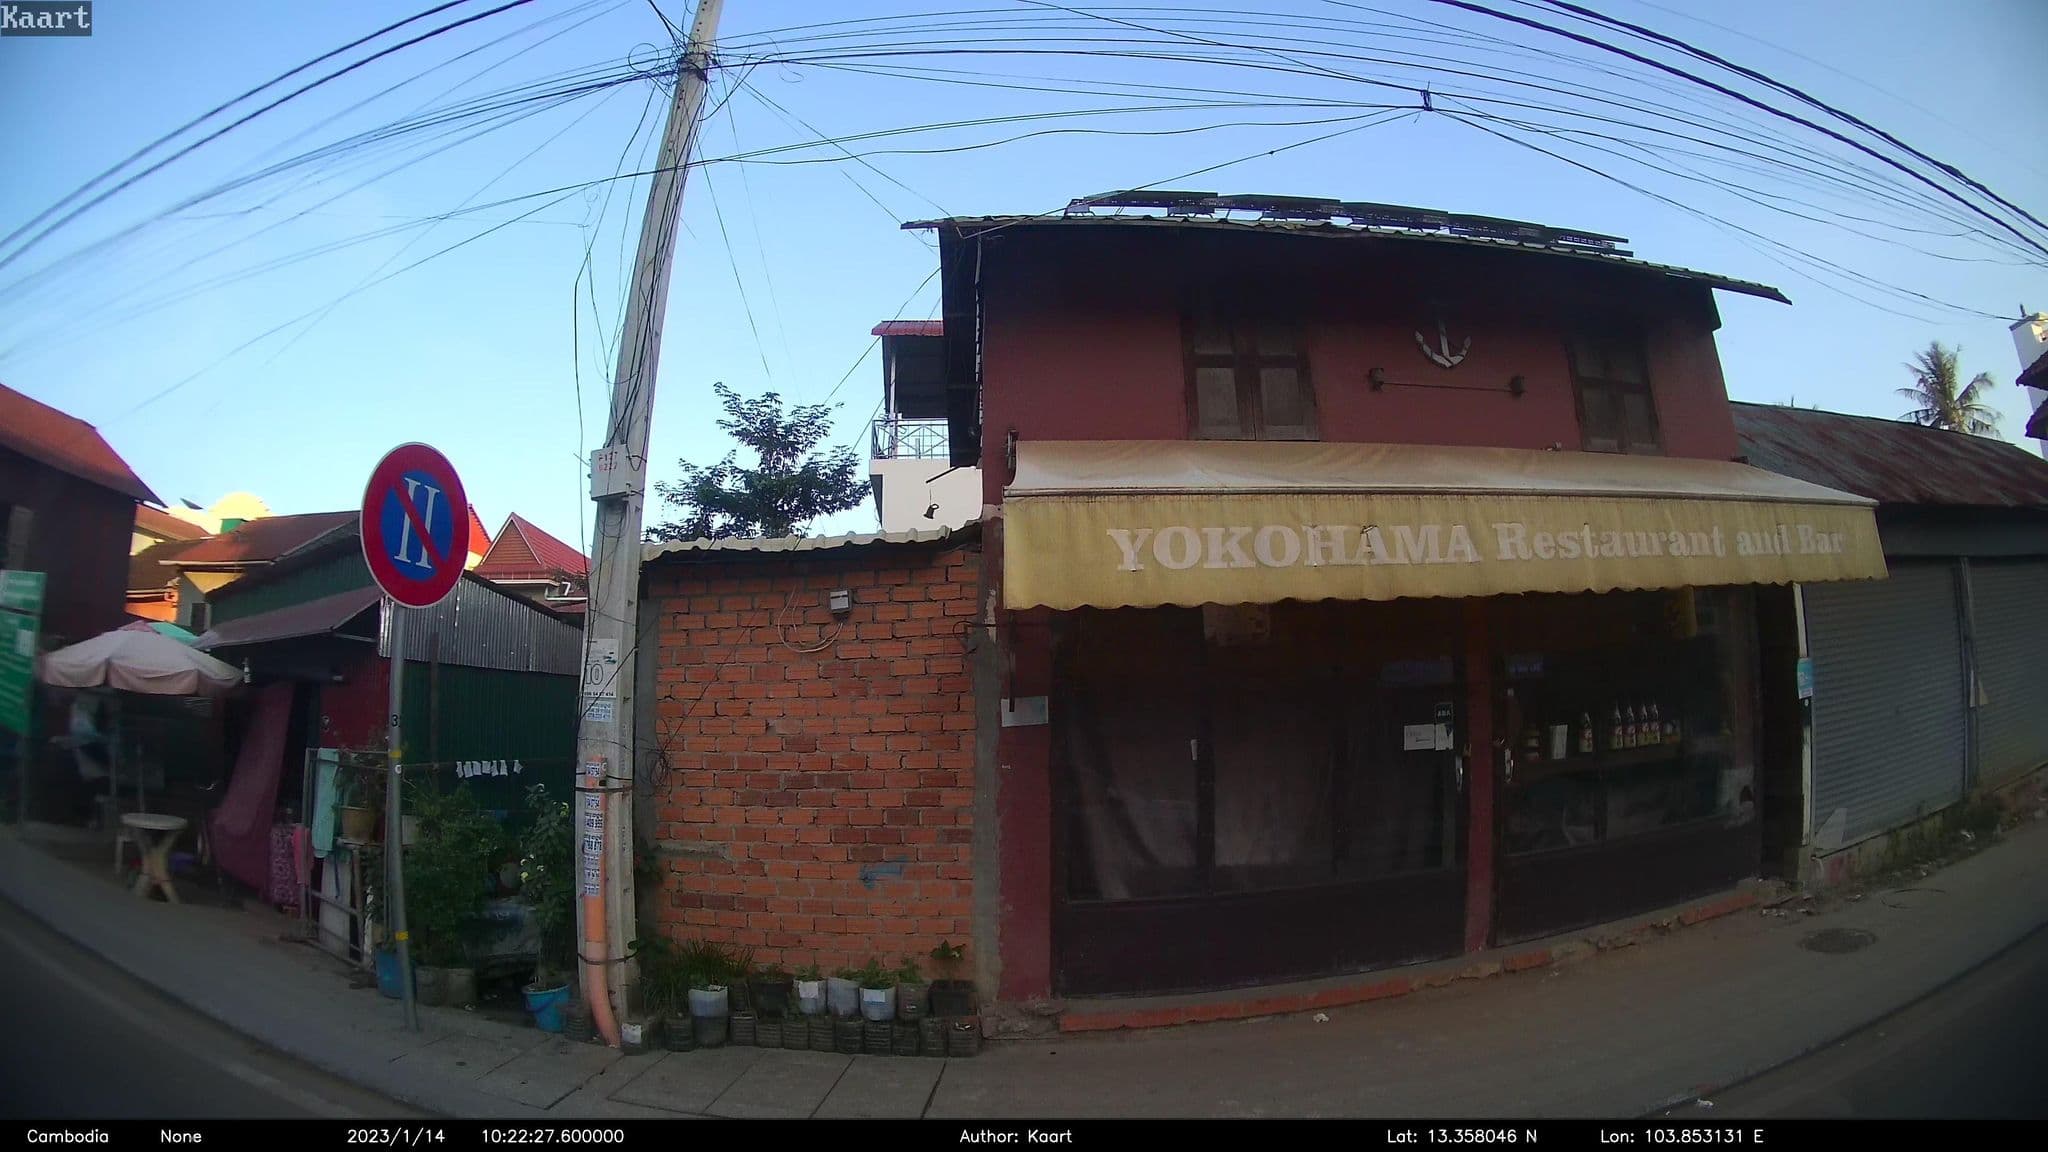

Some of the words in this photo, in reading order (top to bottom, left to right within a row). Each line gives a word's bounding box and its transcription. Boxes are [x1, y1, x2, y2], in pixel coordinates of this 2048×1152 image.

[1106, 524, 1482, 571] YOKOHAMA
[1492, 522, 1727, 560] Restaurant
[1736, 523, 1791, 557] and
[1795, 524, 1845, 555] Bar
